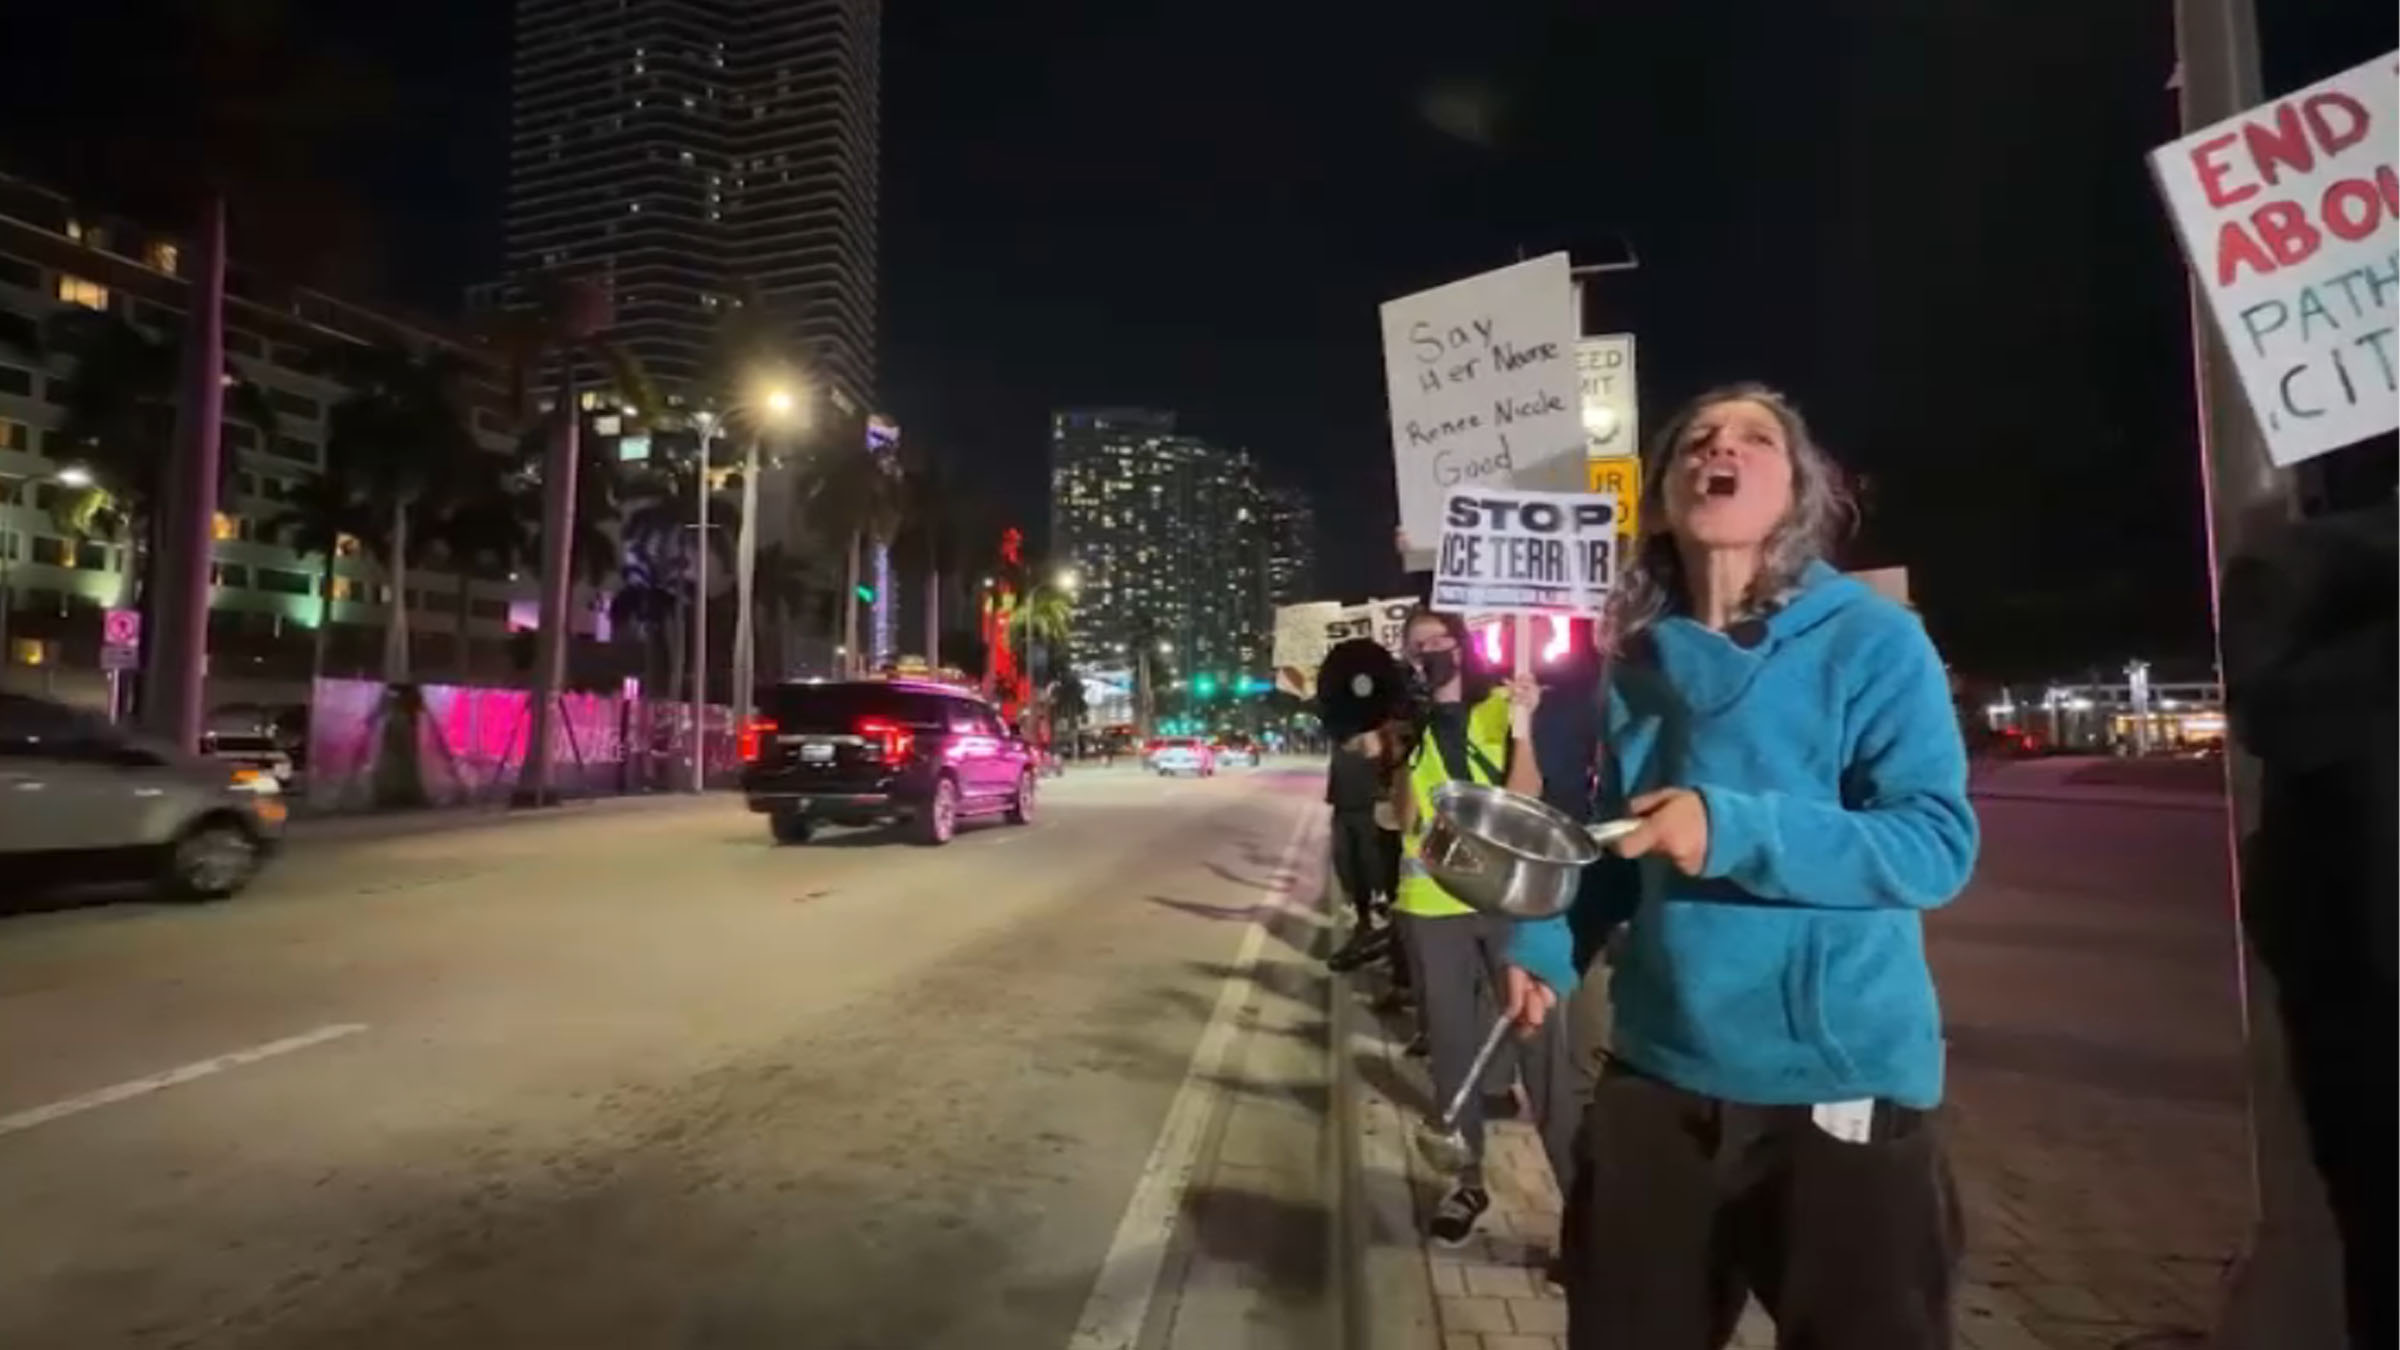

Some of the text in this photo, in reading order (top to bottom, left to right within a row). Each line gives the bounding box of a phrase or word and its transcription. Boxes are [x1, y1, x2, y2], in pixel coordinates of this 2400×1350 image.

[2190, 92, 2369, 209] END
[1410, 318, 1492, 364] Say
[1419, 357, 1481, 393] Her
[2280, 327, 2396, 418] CIT
[1432, 433, 1513, 487] Good
[1447, 496, 1613, 534] STOP
[1440, 532, 1482, 578] ICE
